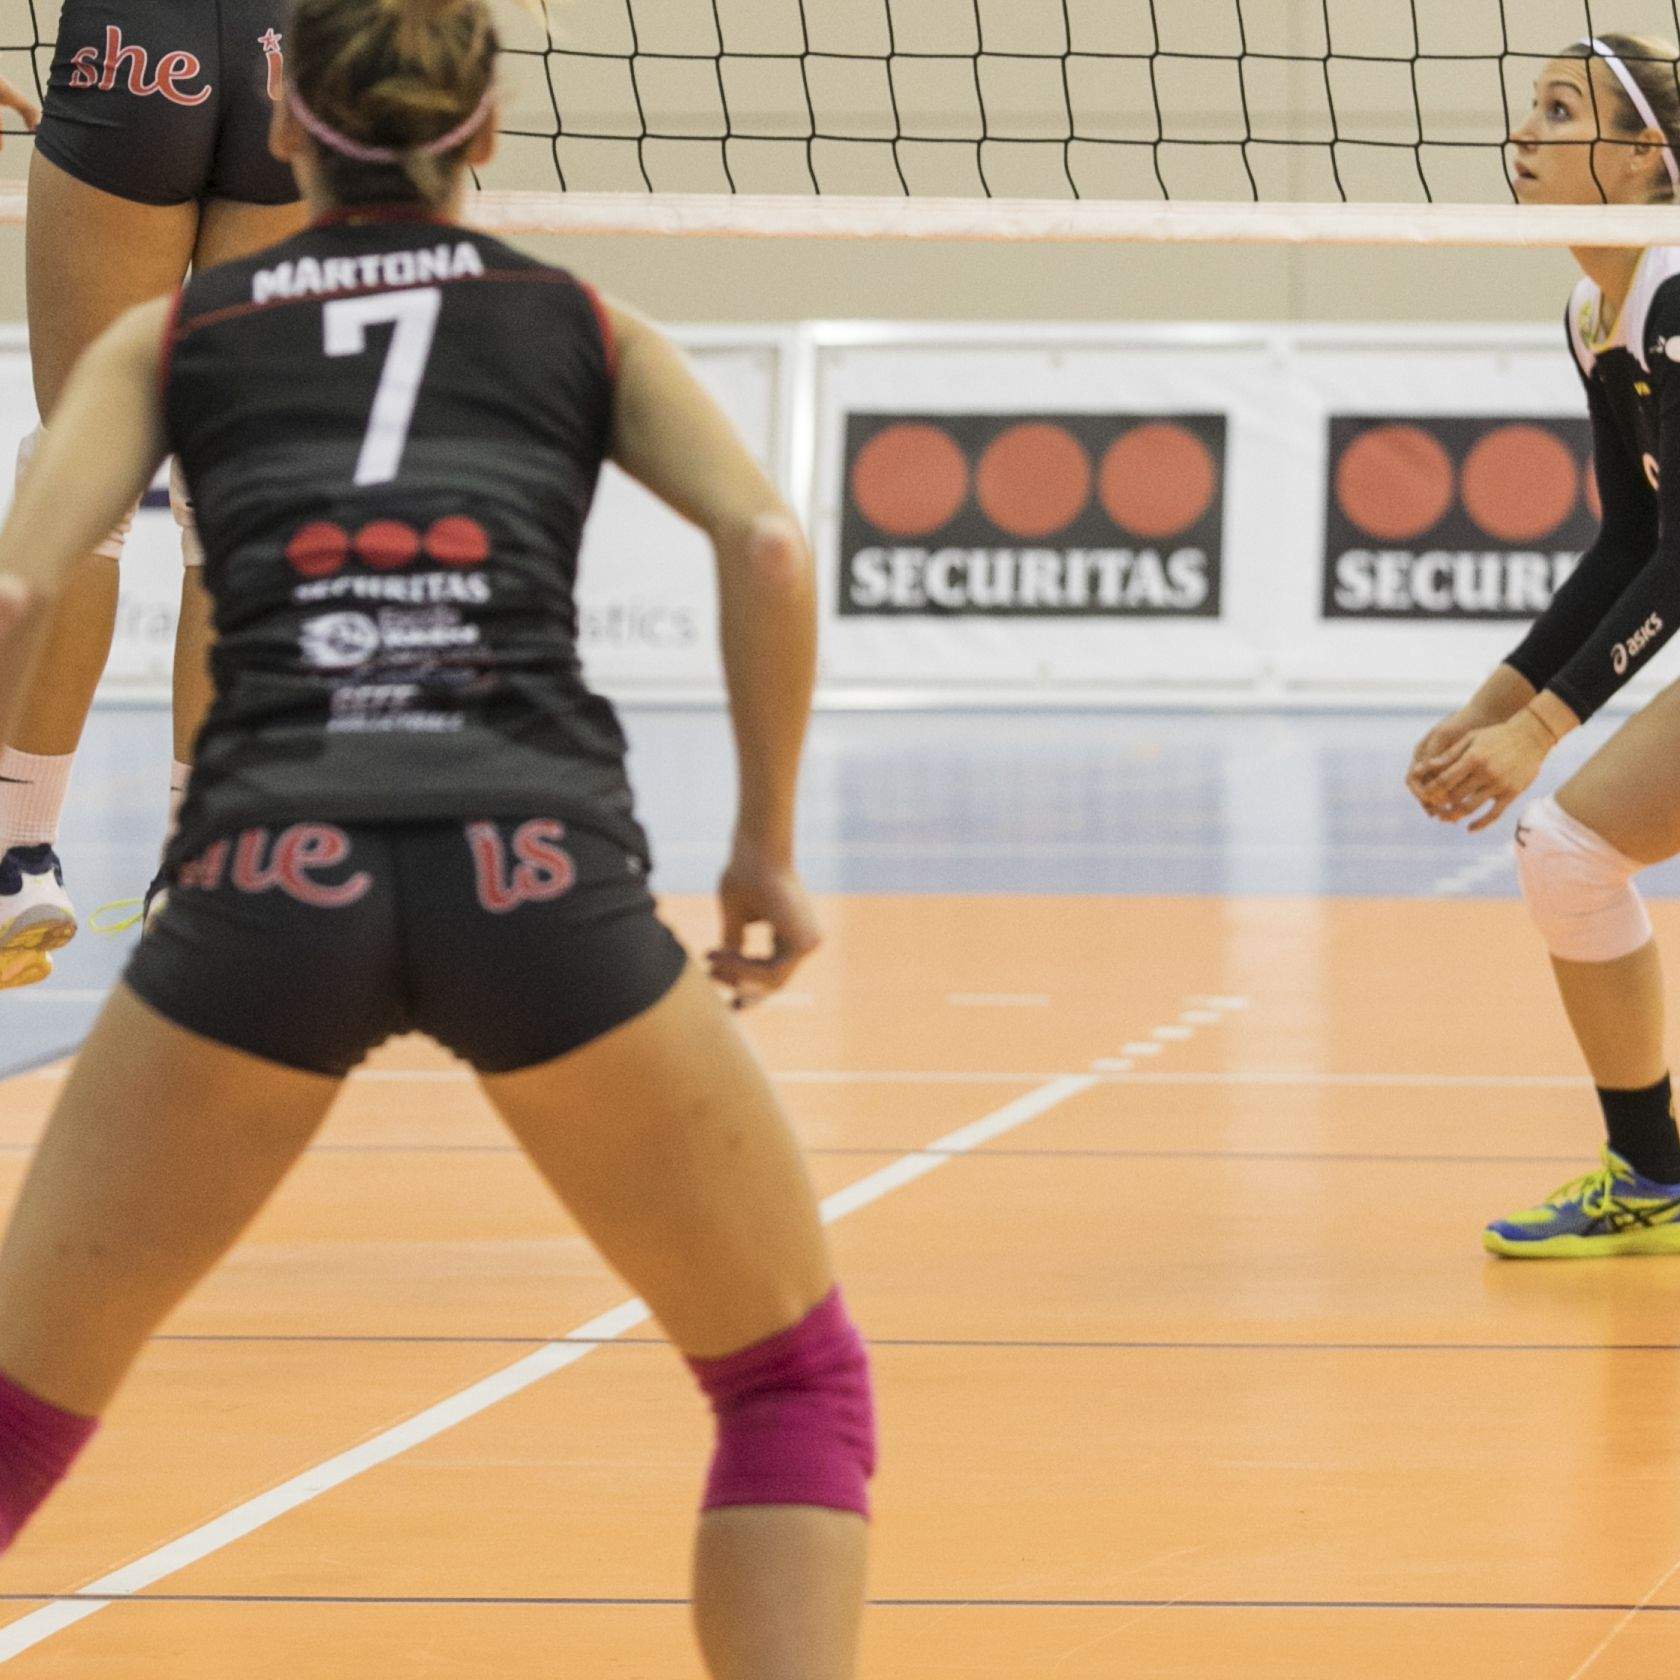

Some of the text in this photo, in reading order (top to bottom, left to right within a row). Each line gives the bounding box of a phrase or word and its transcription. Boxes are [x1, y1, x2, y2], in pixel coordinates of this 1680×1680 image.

[69, 25, 212, 106] she
[252, 240, 484, 305] MARTONA
[323, 286, 442, 487] 7
[849, 546, 1209, 609] SECURITAS
